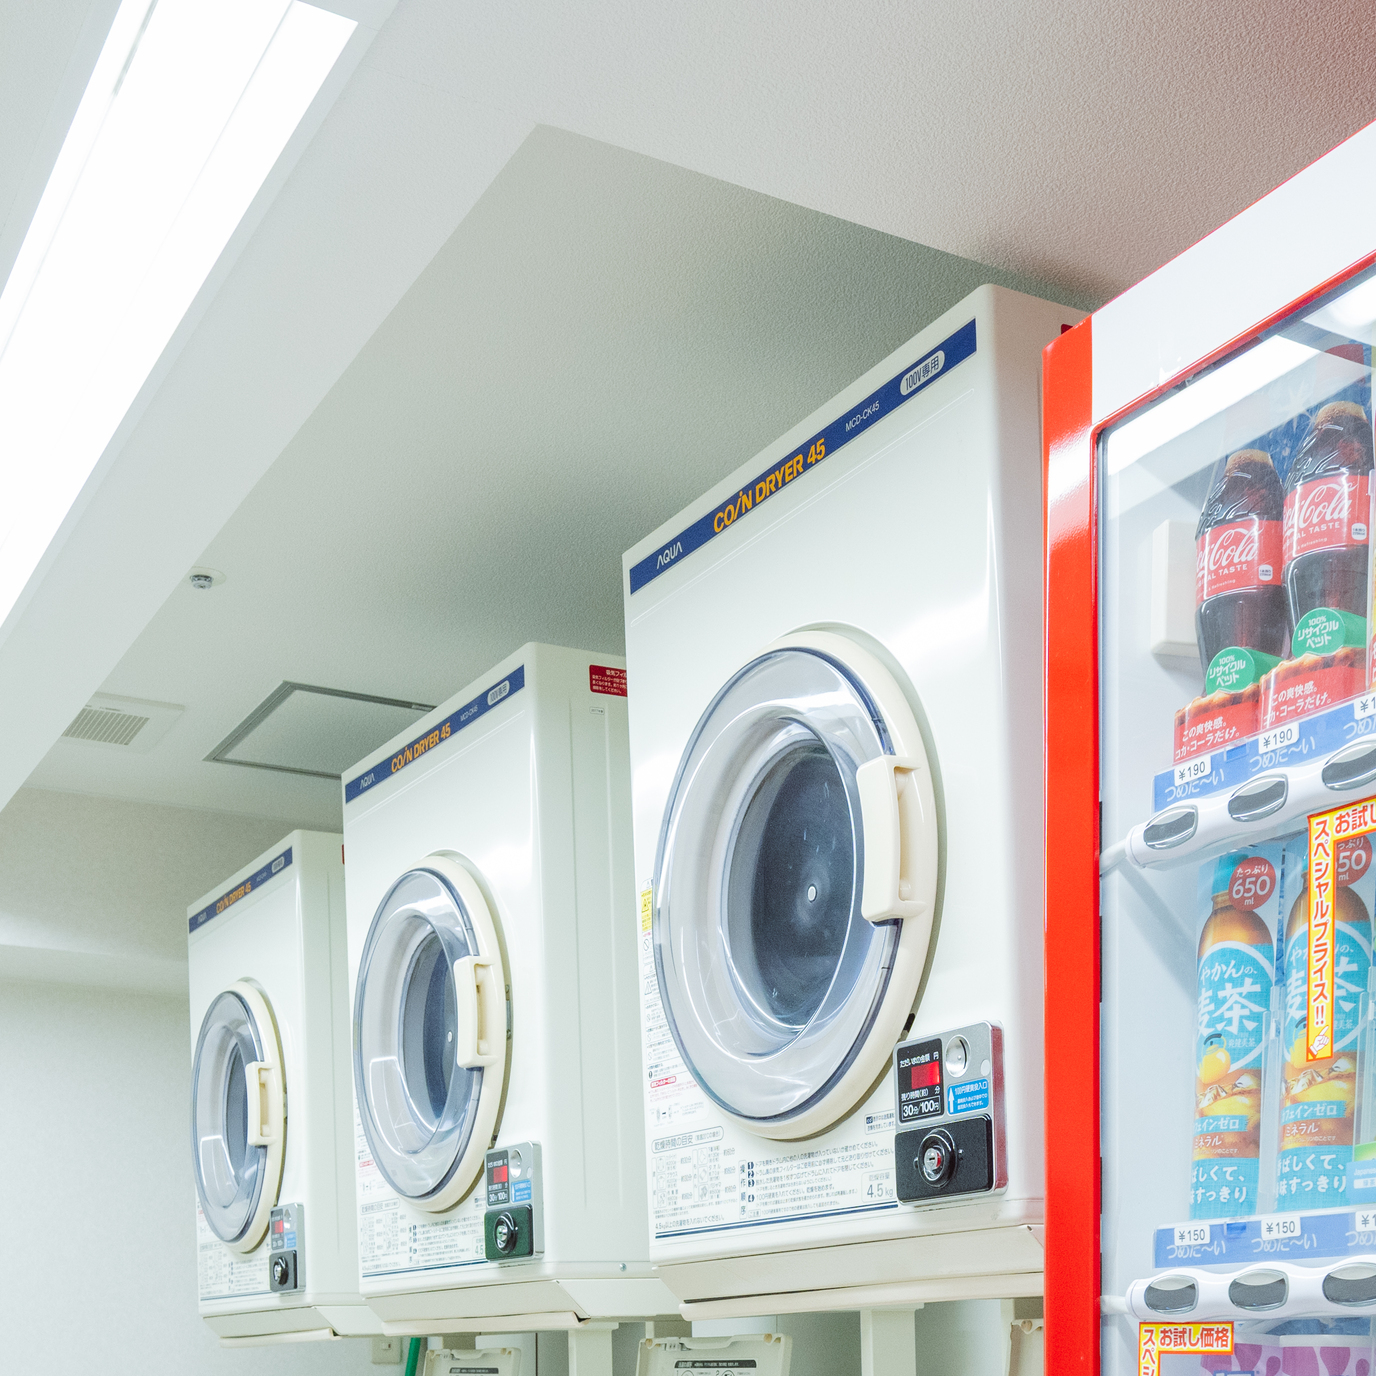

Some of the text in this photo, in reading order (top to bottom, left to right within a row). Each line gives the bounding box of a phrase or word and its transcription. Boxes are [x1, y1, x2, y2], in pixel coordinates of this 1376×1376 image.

[845, 355, 941, 433] MCD-CK45 100V専用
[712, 437, 826, 533] COIN DRYER 45
[1308, 520, 1341, 536] TASTE
[1217, 562, 1249, 577] TASTE
[1297, 619, 1340, 642] リサイクル
[1307, 615, 1327, 626] 100%
[1305, 634, 1332, 649] ペット
[1209, 659, 1247, 680] リサイクル
[1215, 672, 1240, 687] ペット
[1181, 714, 1227, 742] この爽快感。
[1262, 727, 1294, 748] ¥190
[391, 722, 452, 773] COIN DRYER 45
[1175, 728, 1240, 761] コカ・コーラだけ。
[1178, 760, 1207, 781] ¥190
[1235, 863, 1270, 879] たっぷり
[1231, 875, 1272, 898] 650
[1244, 896, 1256, 907] ml
[867, 1183, 884, 1199] 4.5
[1265, 1220, 1296, 1235] ¥150
[1159, 1327, 1230, 1348] お試し価格
